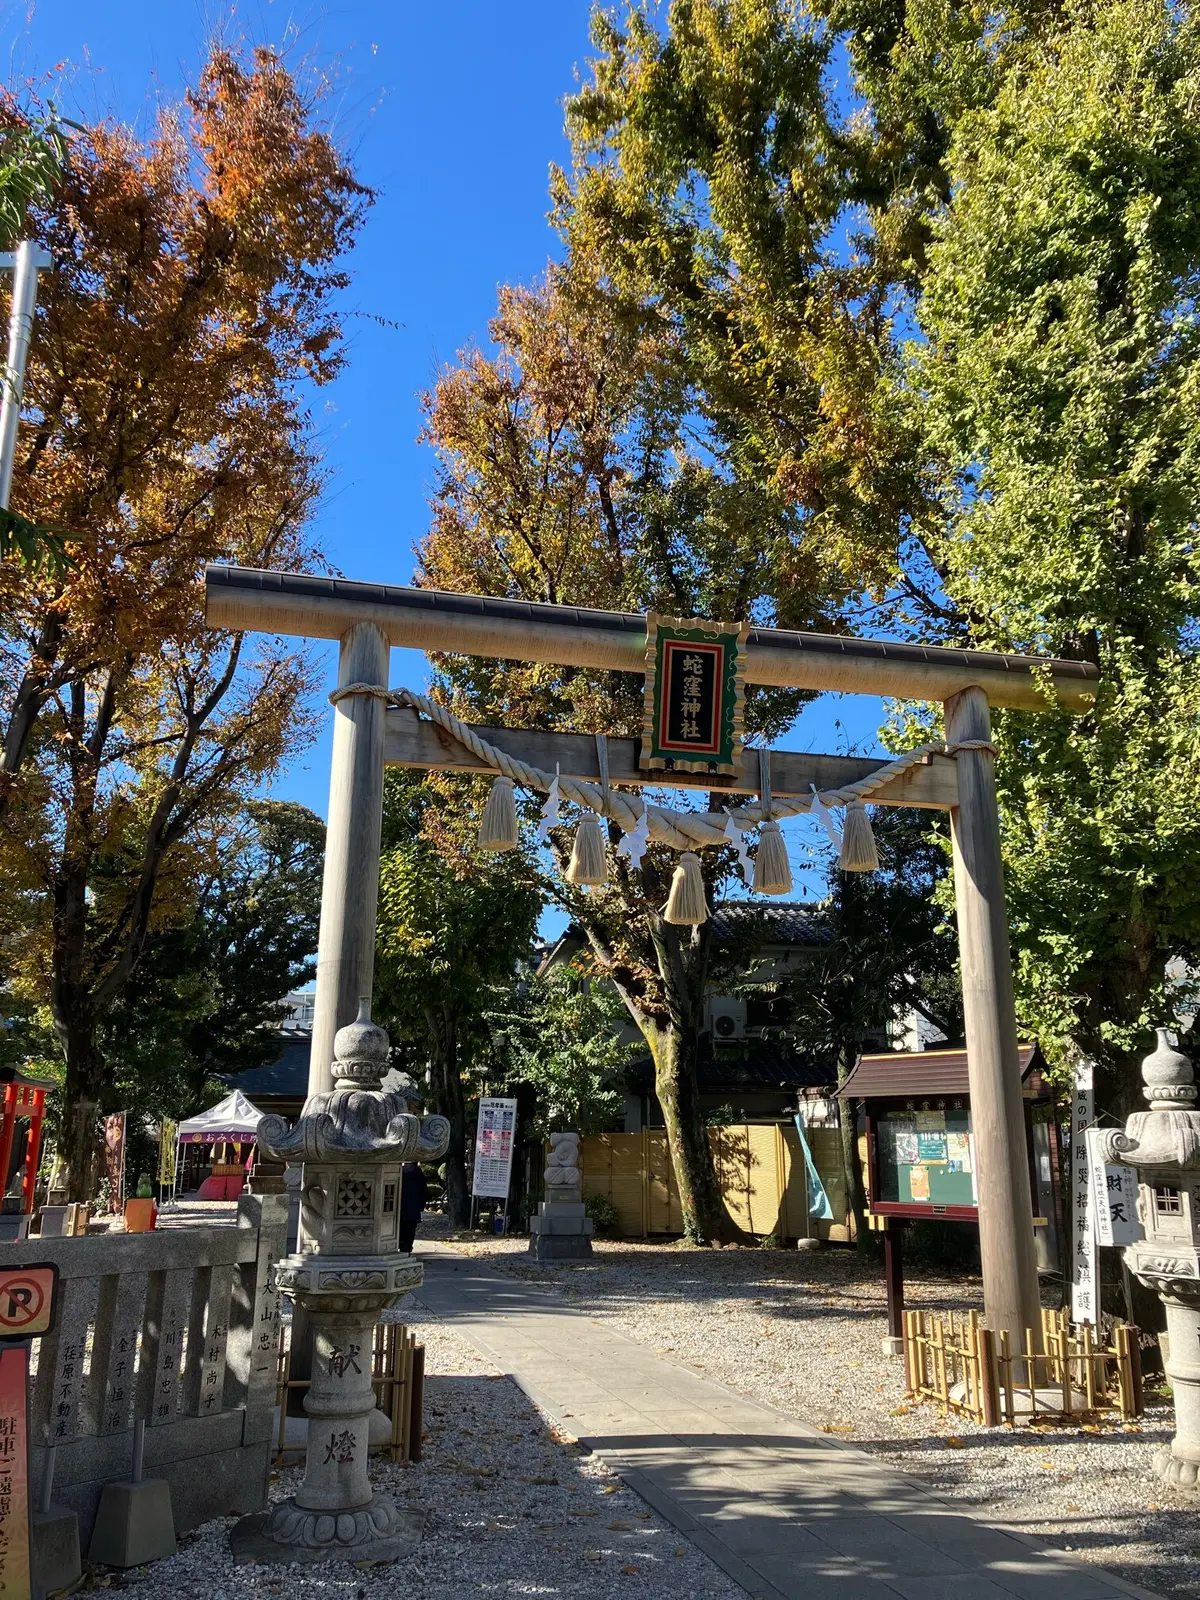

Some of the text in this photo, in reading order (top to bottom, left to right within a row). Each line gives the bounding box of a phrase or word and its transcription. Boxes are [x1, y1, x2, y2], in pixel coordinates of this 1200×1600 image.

[680, 654, 704, 739] 蛇窪神社
[906, 1099, 962, 1111] 蛇窪神社
[204, 1325, 222, 1409] 木村尚子
[256, 1278, 274, 1372] 大山忠一
[55, 1344, 77, 1437] 荏原不動産
[108, 1337, 128, 1428] 金子恒治
[157, 1331, 176, 1419] 川島忠雄
